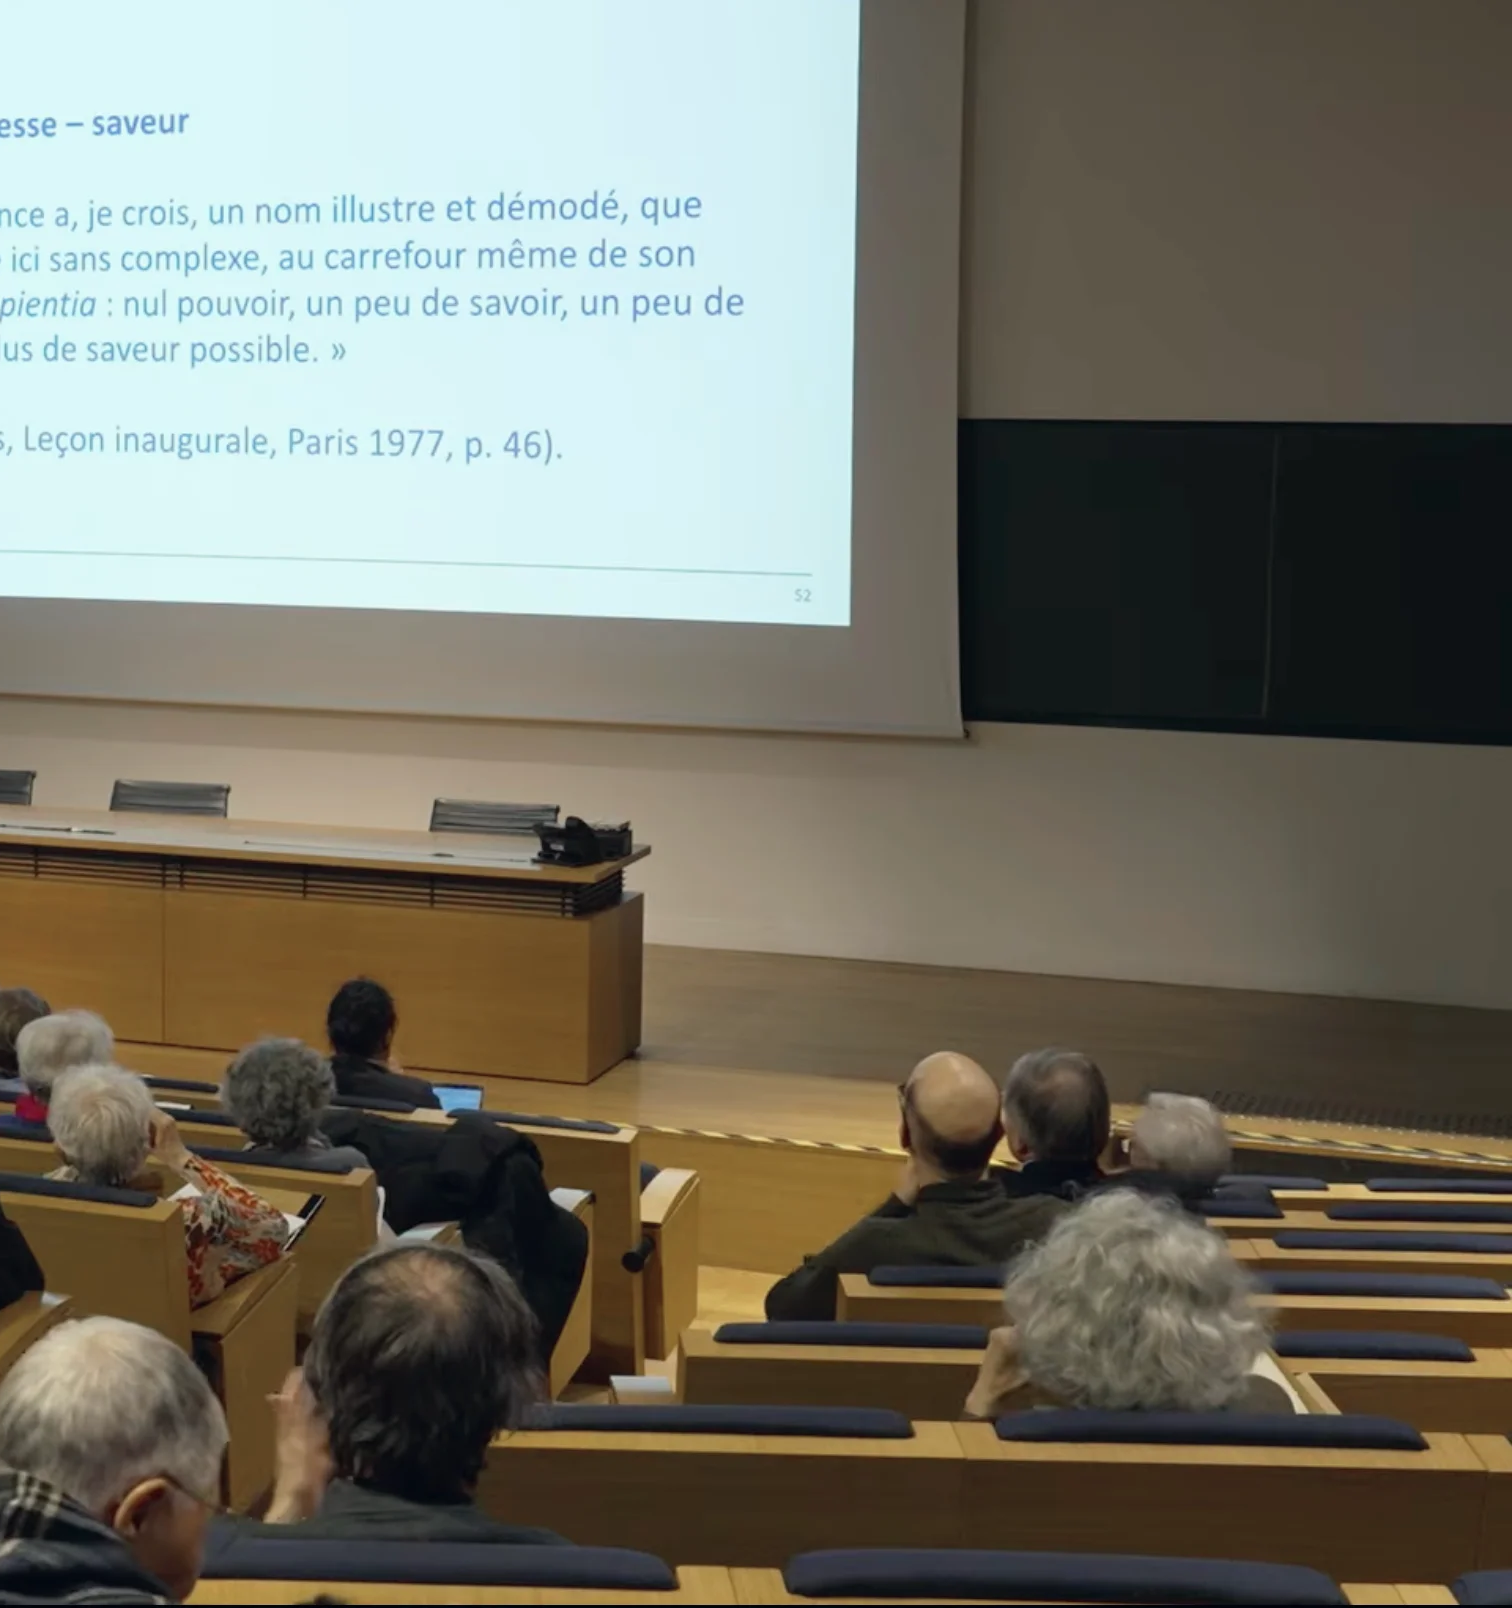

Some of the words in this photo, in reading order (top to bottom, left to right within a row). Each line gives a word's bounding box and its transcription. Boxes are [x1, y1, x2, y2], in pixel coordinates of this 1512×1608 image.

[92, 112, 190, 137] saveur
[54, 206, 78, 233] a,
[86, 199, 113, 234] je
[122, 198, 197, 231] crois,
[208, 203, 245, 226] un
[255, 202, 321, 225] nom
[332, 193, 436, 224] illustre
[446, 195, 477, 223] et
[486, 188, 629, 226] démodé,
[640, 196, 703, 227] que
[11, 245, 40, 273] ici
[49, 250, 112, 273] sans
[120, 242, 268, 278] complexe,
[278, 249, 314, 271] au
[324, 239, 467, 271] carrefour
[477, 237, 578, 270] même
[588, 237, 628, 269] de
[638, 245, 695, 268] son
[107, 297, 113, 317] :
[123, 288, 167, 318] nul
[177, 288, 295, 324] pouvoir,
[306, 295, 343, 317] un
[354, 295, 411, 324] peu
[421, 286, 460, 317] de
[469, 287, 568, 322] savoir,
[580, 294, 620, 317] un
[632, 294, 692, 324] peu
[703, 285, 745, 317] de
[42, 333, 77, 363] de
[86, 341, 181, 363] saveur
[190, 333, 318, 369] possible.
[24, 425, 105, 459] Leçon
[115, 425, 277, 461] inaugurale,
[288, 427, 358, 457] Paris
[370, 428, 453, 463] 1977,
[465, 436, 492, 465] p.
[502, 428, 563, 466] 46).
[794, 588, 812, 603] 52
